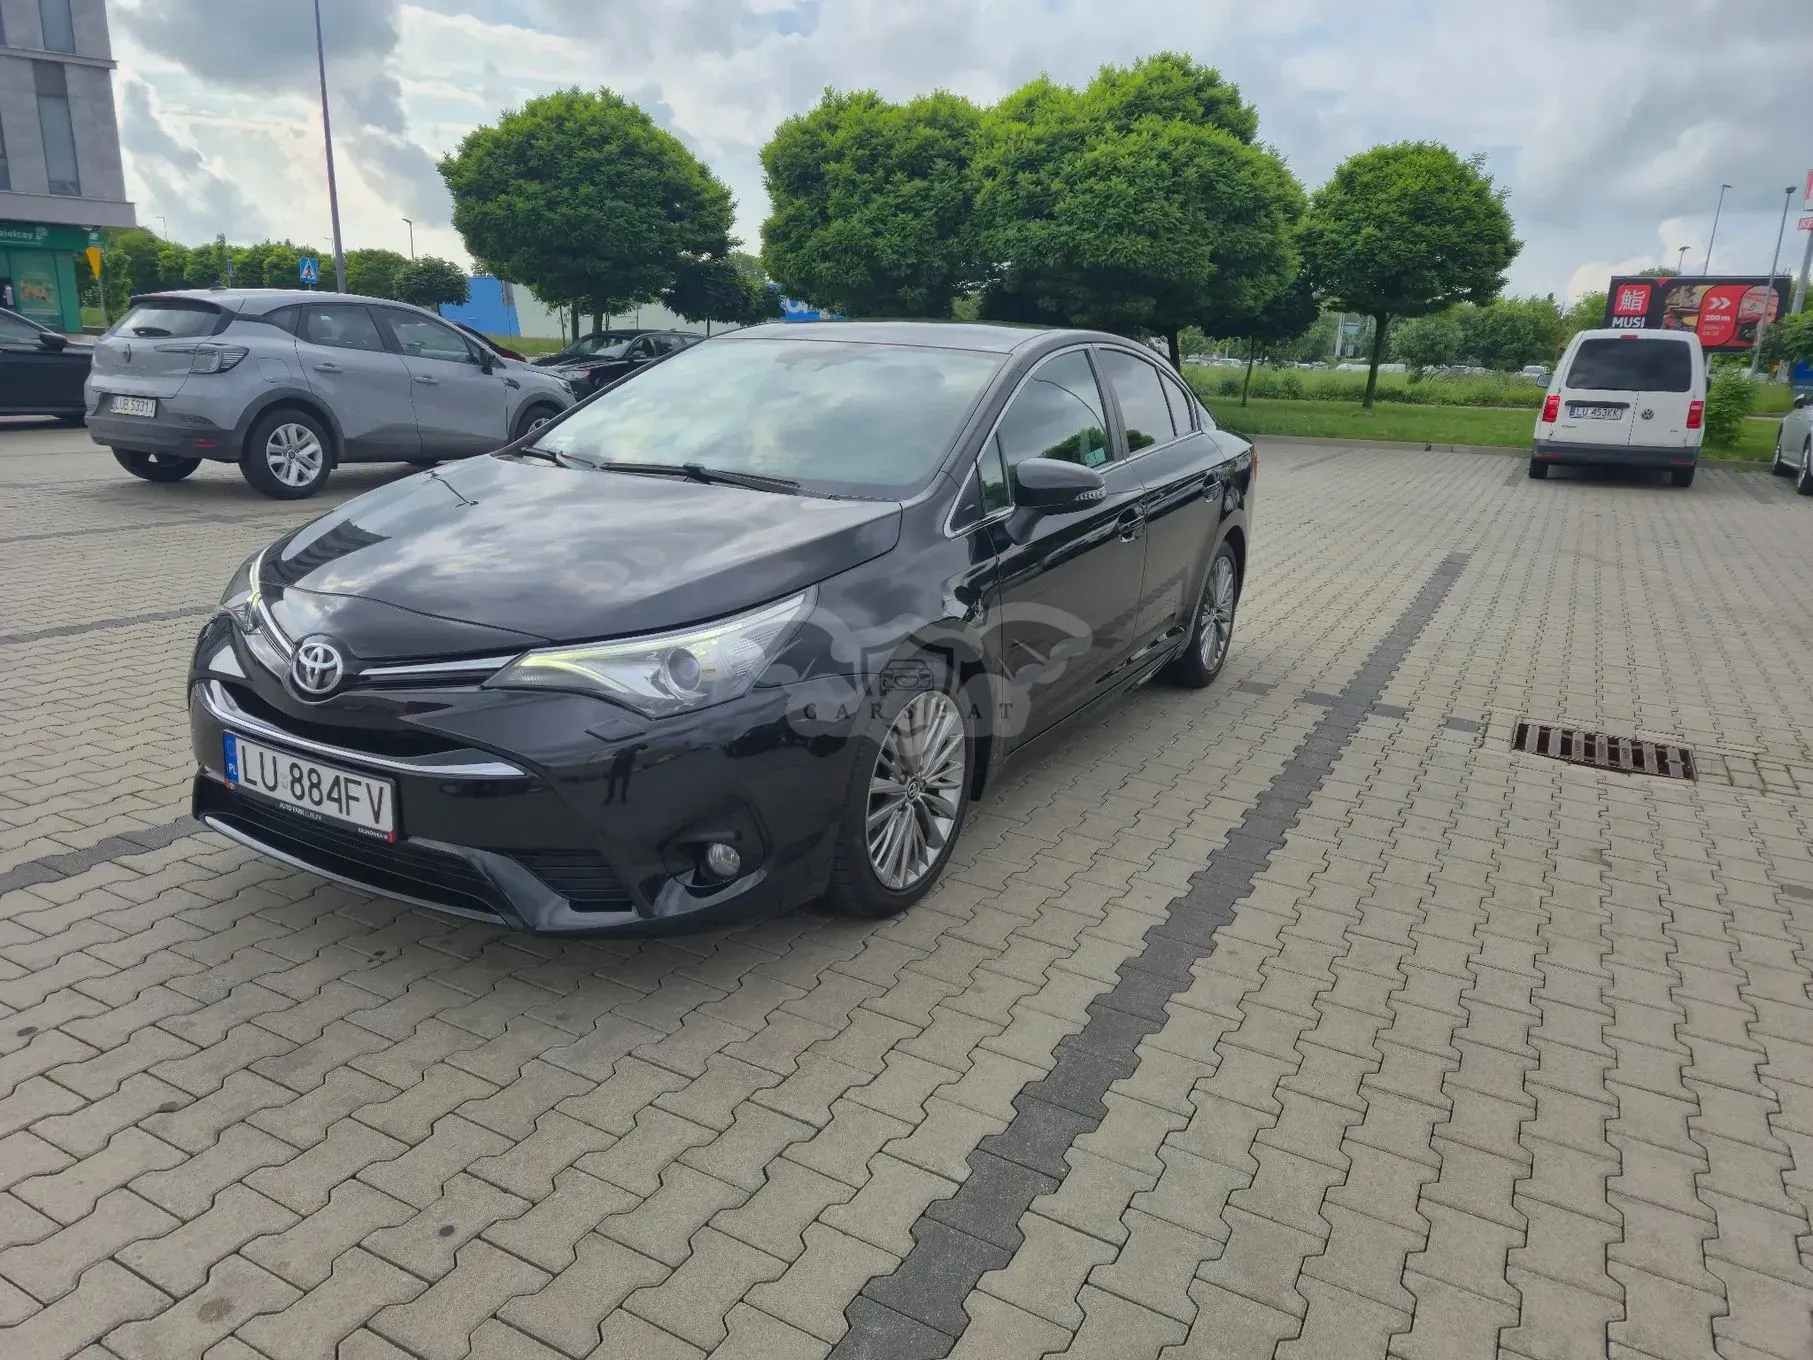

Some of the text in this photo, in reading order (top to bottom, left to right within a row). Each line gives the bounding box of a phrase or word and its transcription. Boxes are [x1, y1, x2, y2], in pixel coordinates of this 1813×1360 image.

[1611, 316, 1645, 328] MUSI
[1576, 407, 1618, 418] LU 453KK
[228, 762, 238, 776] PL
[241, 745, 384, 825] LU 884FV
